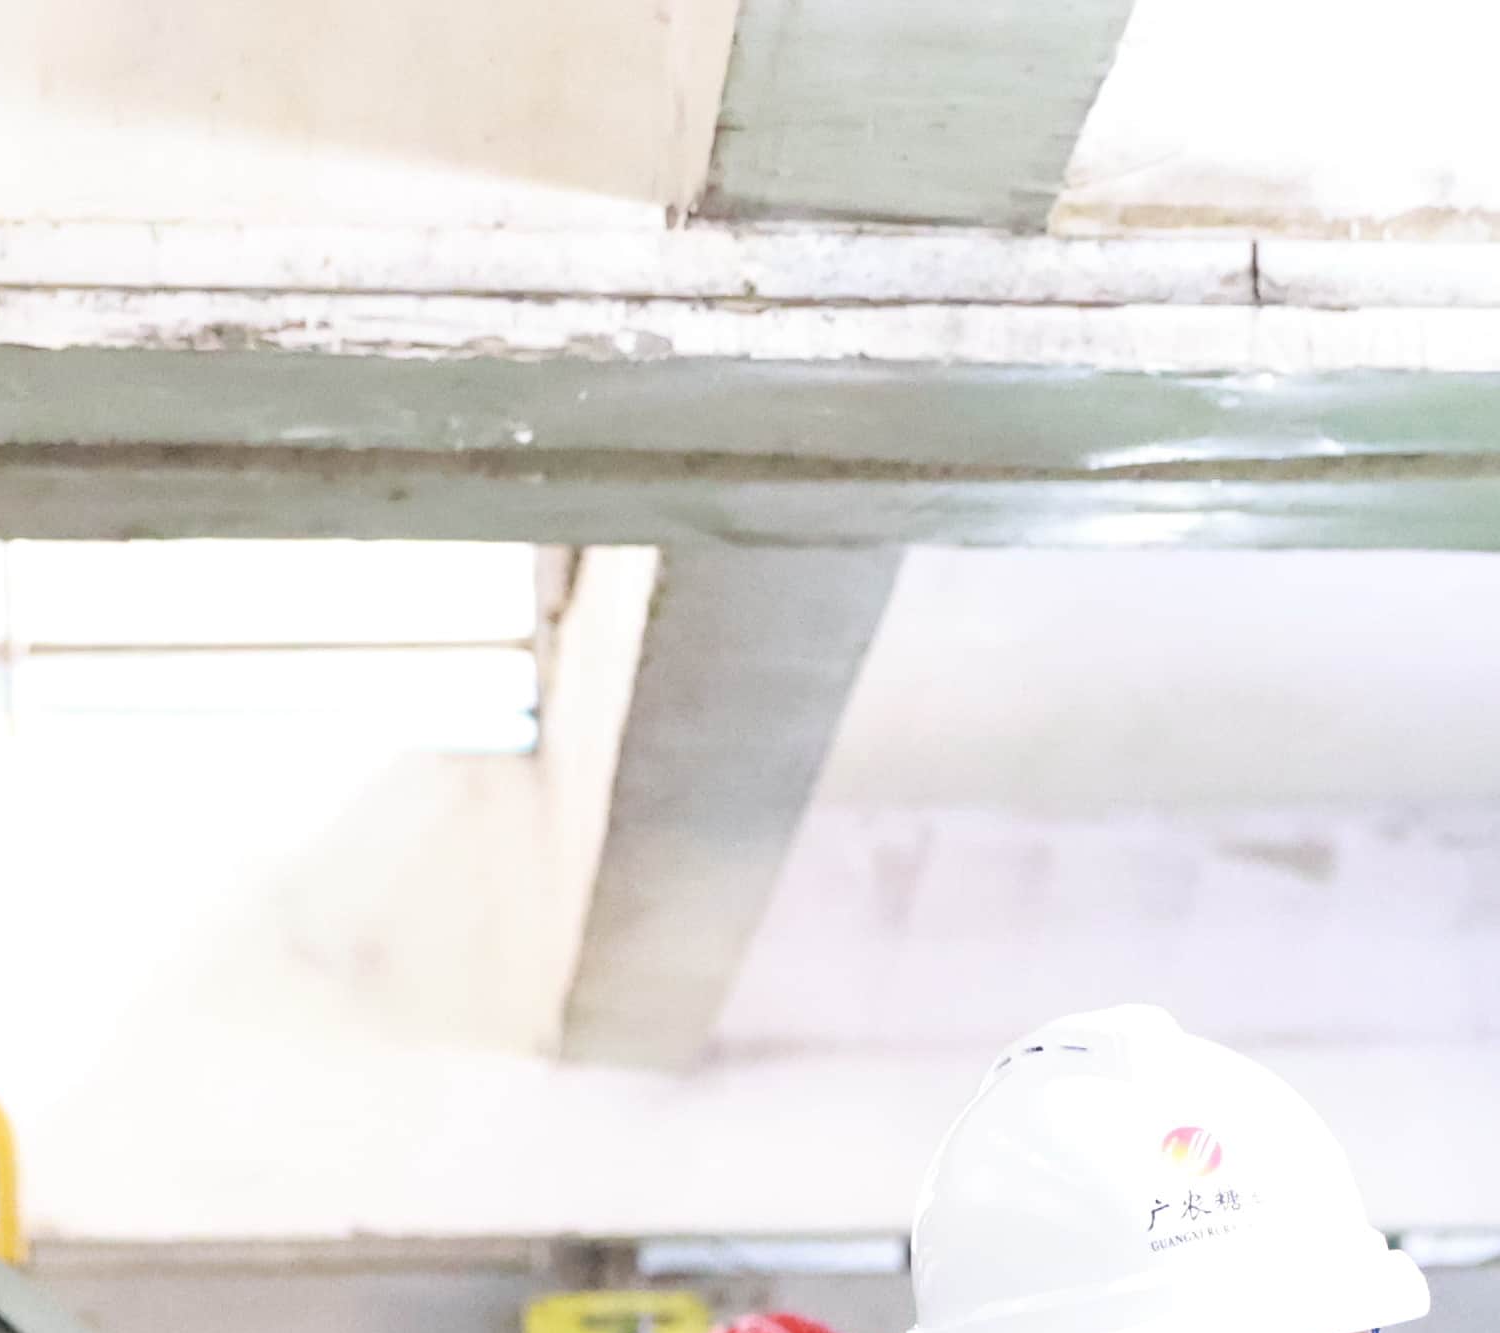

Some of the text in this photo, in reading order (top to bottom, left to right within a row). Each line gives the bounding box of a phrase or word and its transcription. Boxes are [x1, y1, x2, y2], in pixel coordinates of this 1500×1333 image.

[1148, 1187, 1262, 1232] 广农糖
[1150, 1229, 1204, 1252] GUANGXI
